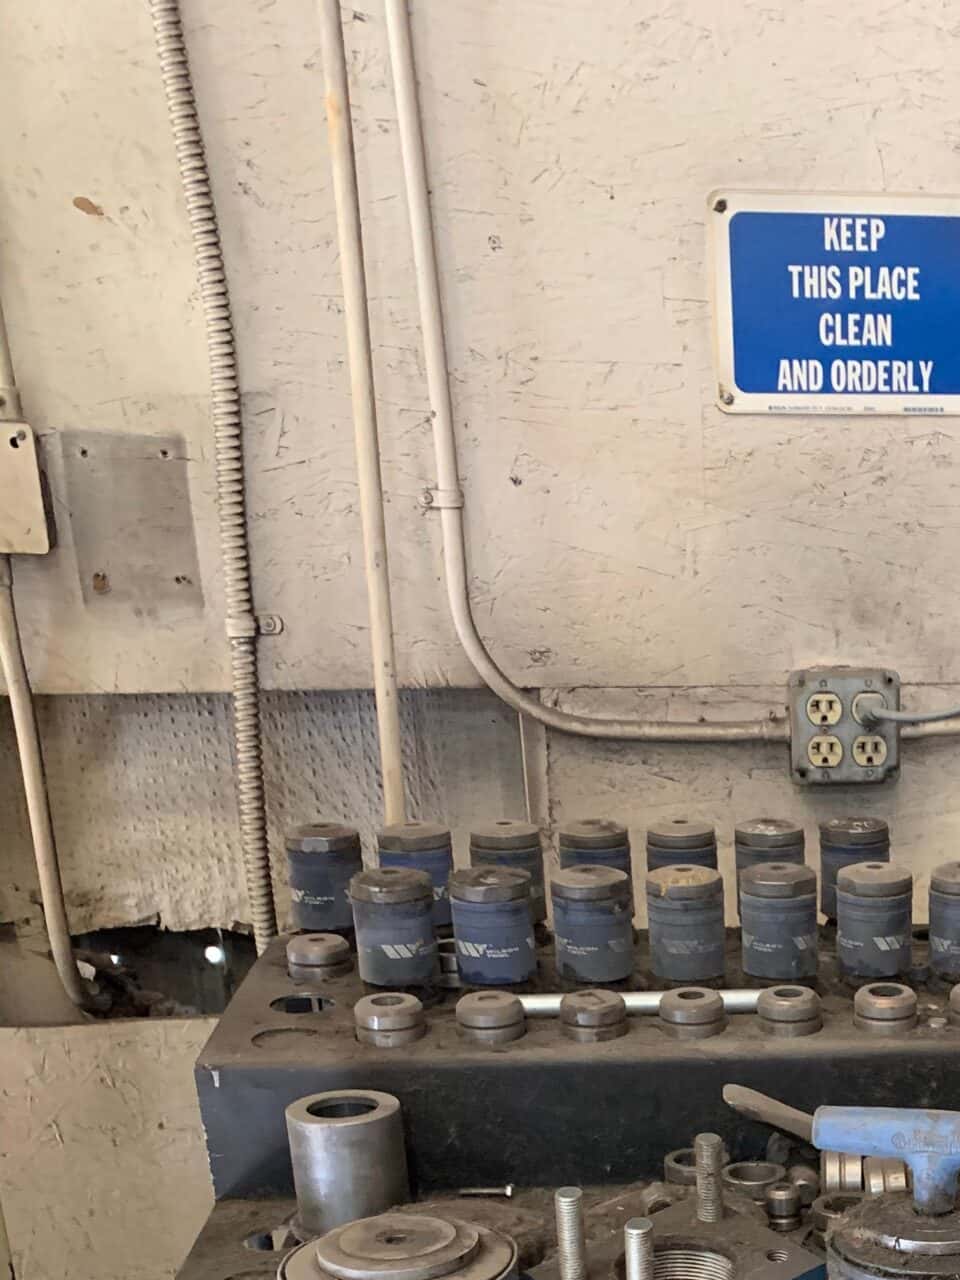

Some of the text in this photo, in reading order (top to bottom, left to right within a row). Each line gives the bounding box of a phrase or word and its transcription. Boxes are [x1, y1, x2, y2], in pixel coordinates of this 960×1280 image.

[824, 217, 885, 252] KEEP
[788, 265, 921, 300] THIS PLACE
[819, 313, 892, 346] CLEAN
[777, 359, 933, 392] AND ORDERLY
